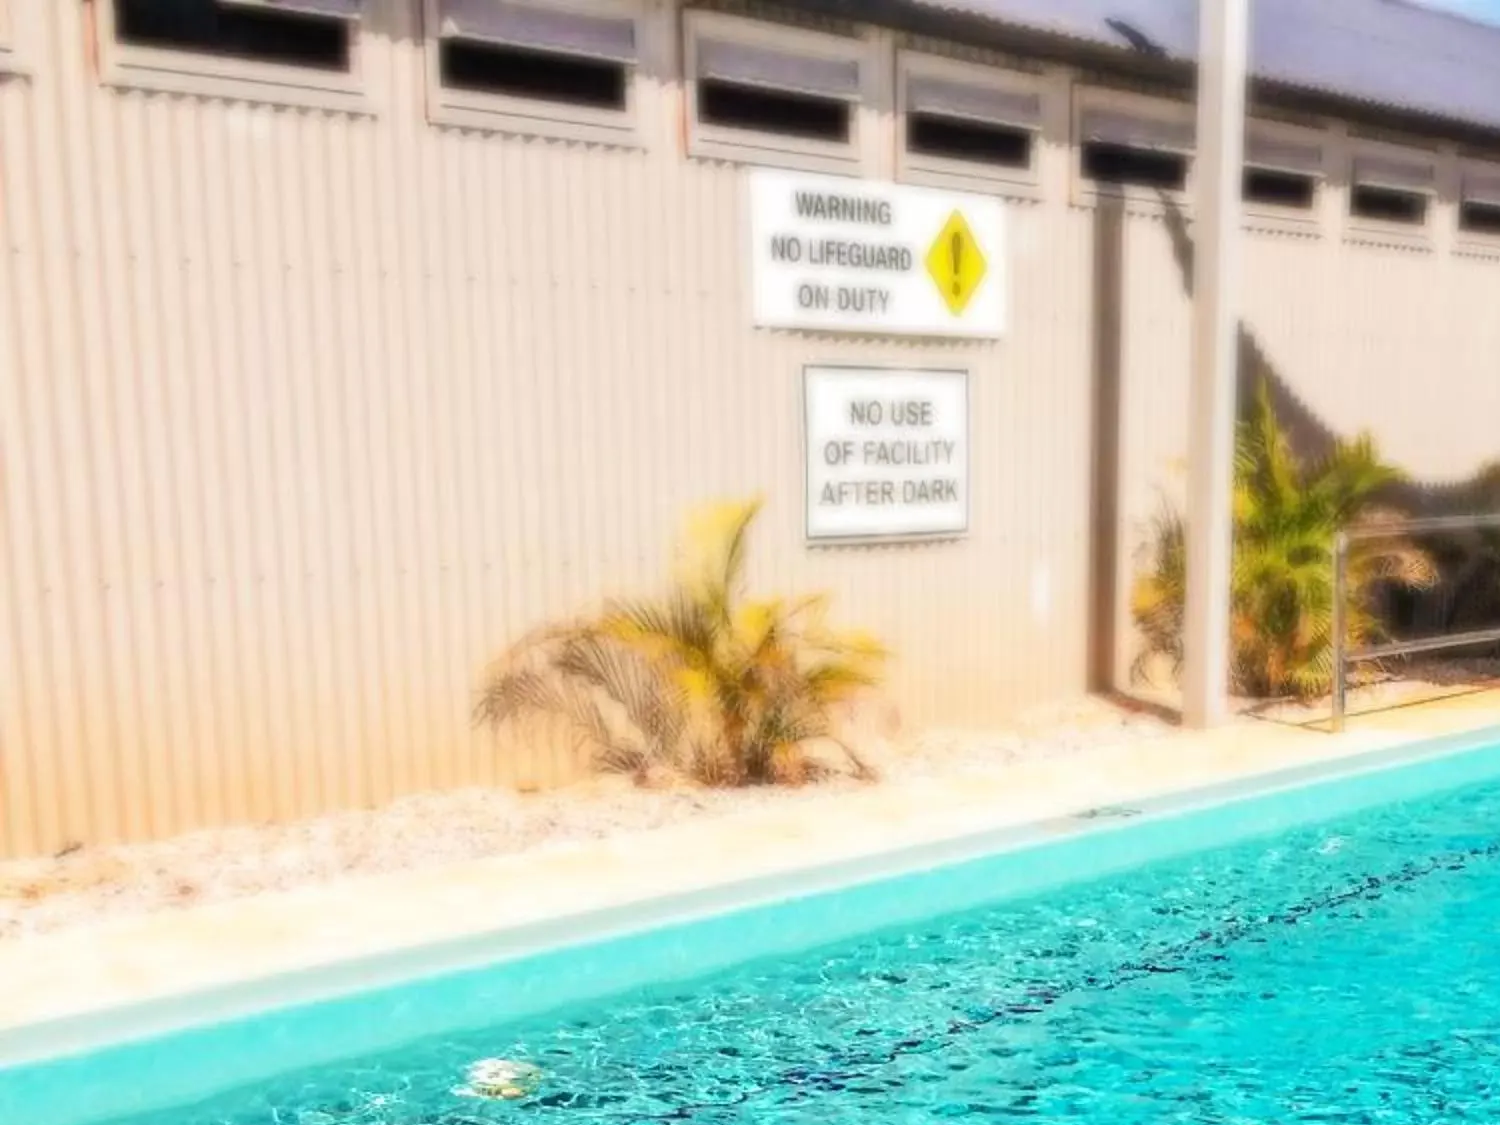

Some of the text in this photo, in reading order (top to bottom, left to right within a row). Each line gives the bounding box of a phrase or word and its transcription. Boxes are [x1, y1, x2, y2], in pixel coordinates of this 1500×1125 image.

[795, 191, 892, 225] WARNING
[771, 237, 912, 272] NO LIFEGUARD
[798, 284, 890, 314] ON DUTY
[850, 401, 933, 426] NO USE
[824, 440, 956, 466] OF FACILITY
[819, 479, 958, 506] AFTER DARK
